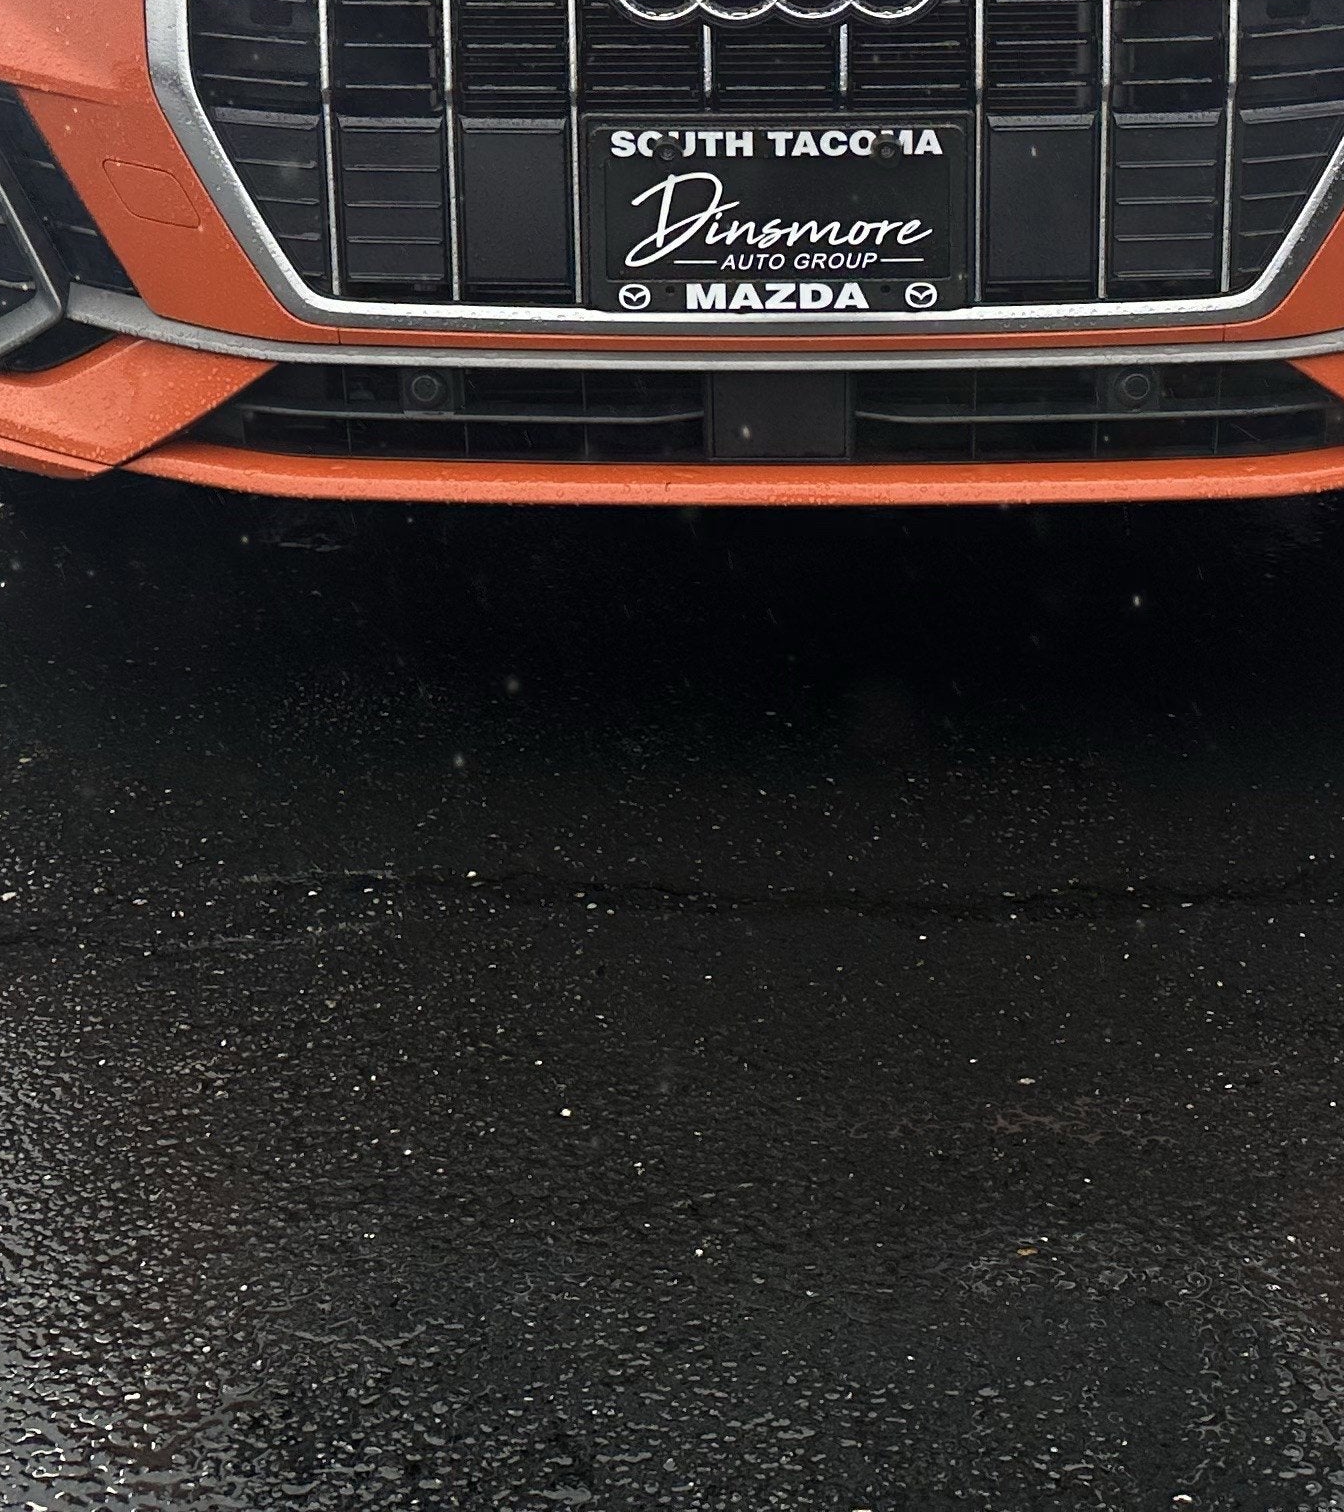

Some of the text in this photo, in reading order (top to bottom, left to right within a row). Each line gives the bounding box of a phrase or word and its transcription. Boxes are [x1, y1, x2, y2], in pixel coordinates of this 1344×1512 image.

[624, 171, 934, 268] Dinsmore
[719, 252, 879, 271] AUTO GROUP
[685, 282, 870, 311] MAZDA
